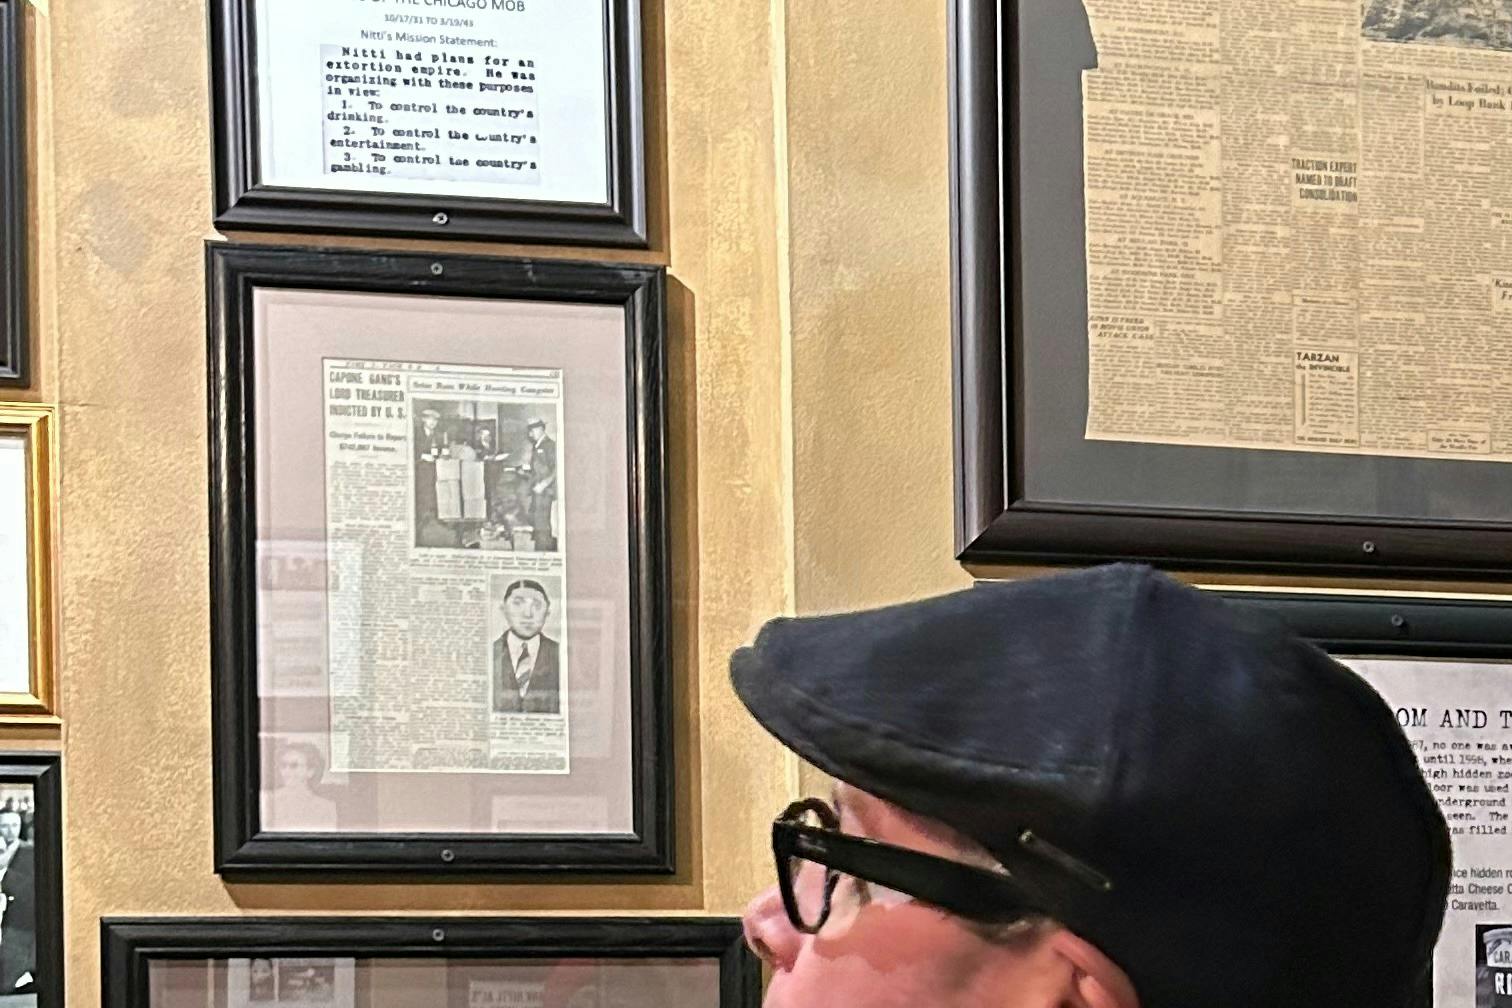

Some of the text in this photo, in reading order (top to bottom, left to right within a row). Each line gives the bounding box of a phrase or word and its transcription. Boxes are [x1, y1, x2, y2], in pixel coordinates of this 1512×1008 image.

[492, 1, 525, 12] MOB
[360, 30, 498, 48] Nitti's Mission Statement:
[342, 47, 535, 68] Nitti had plans for an
[326, 60, 402, 73] extortion
[486, 68, 502, 78] He
[511, 71, 535, 80] was
[325, 73, 534, 93] organizing with these purposes
[327, 87, 341, 95] in
[342, 100, 534, 119] 1. To control the country's
[327, 111, 389, 124] drinking.
[343, 126, 355, 136] 2.
[371, 127, 385, 136] To
[393, 128, 440, 139] control
[448, 130, 469, 141] the
[330, 139, 426, 151] entertainment.
[371, 153, 386, 162] To
[393, 155, 441, 165] control
[331, 163, 391, 175] gambling.
[1296, 352, 1340, 362] TARZAN
[329, 372, 363, 384] CAPONE
[371, 406, 381, 417] BY
[1395, 708, 1427, 727] OM
[1440, 710, 1488, 729] AND
[1432, 741, 1446, 750] no
[1451, 741, 1471, 751] one
[1477, 743, 1497, 751] was
[1423, 755, 1456, 764] until
[1453, 770, 1492, 779] hidden
[1427, 783, 1453, 793] loor
[1458, 785, 1479, 793] was
[1484, 783, 1509, 794] used
[1437, 797, 1506, 808] nderground
[1489, 812, 1509, 822] The
[1449, 826, 1465, 835] as
[1469, 825, 1506, 835] filled
[1470, 867, 1503, 879] hidden
[1468, 883, 1504, 895] Cheese
[1451, 899, 1500, 911] Caravetta.
